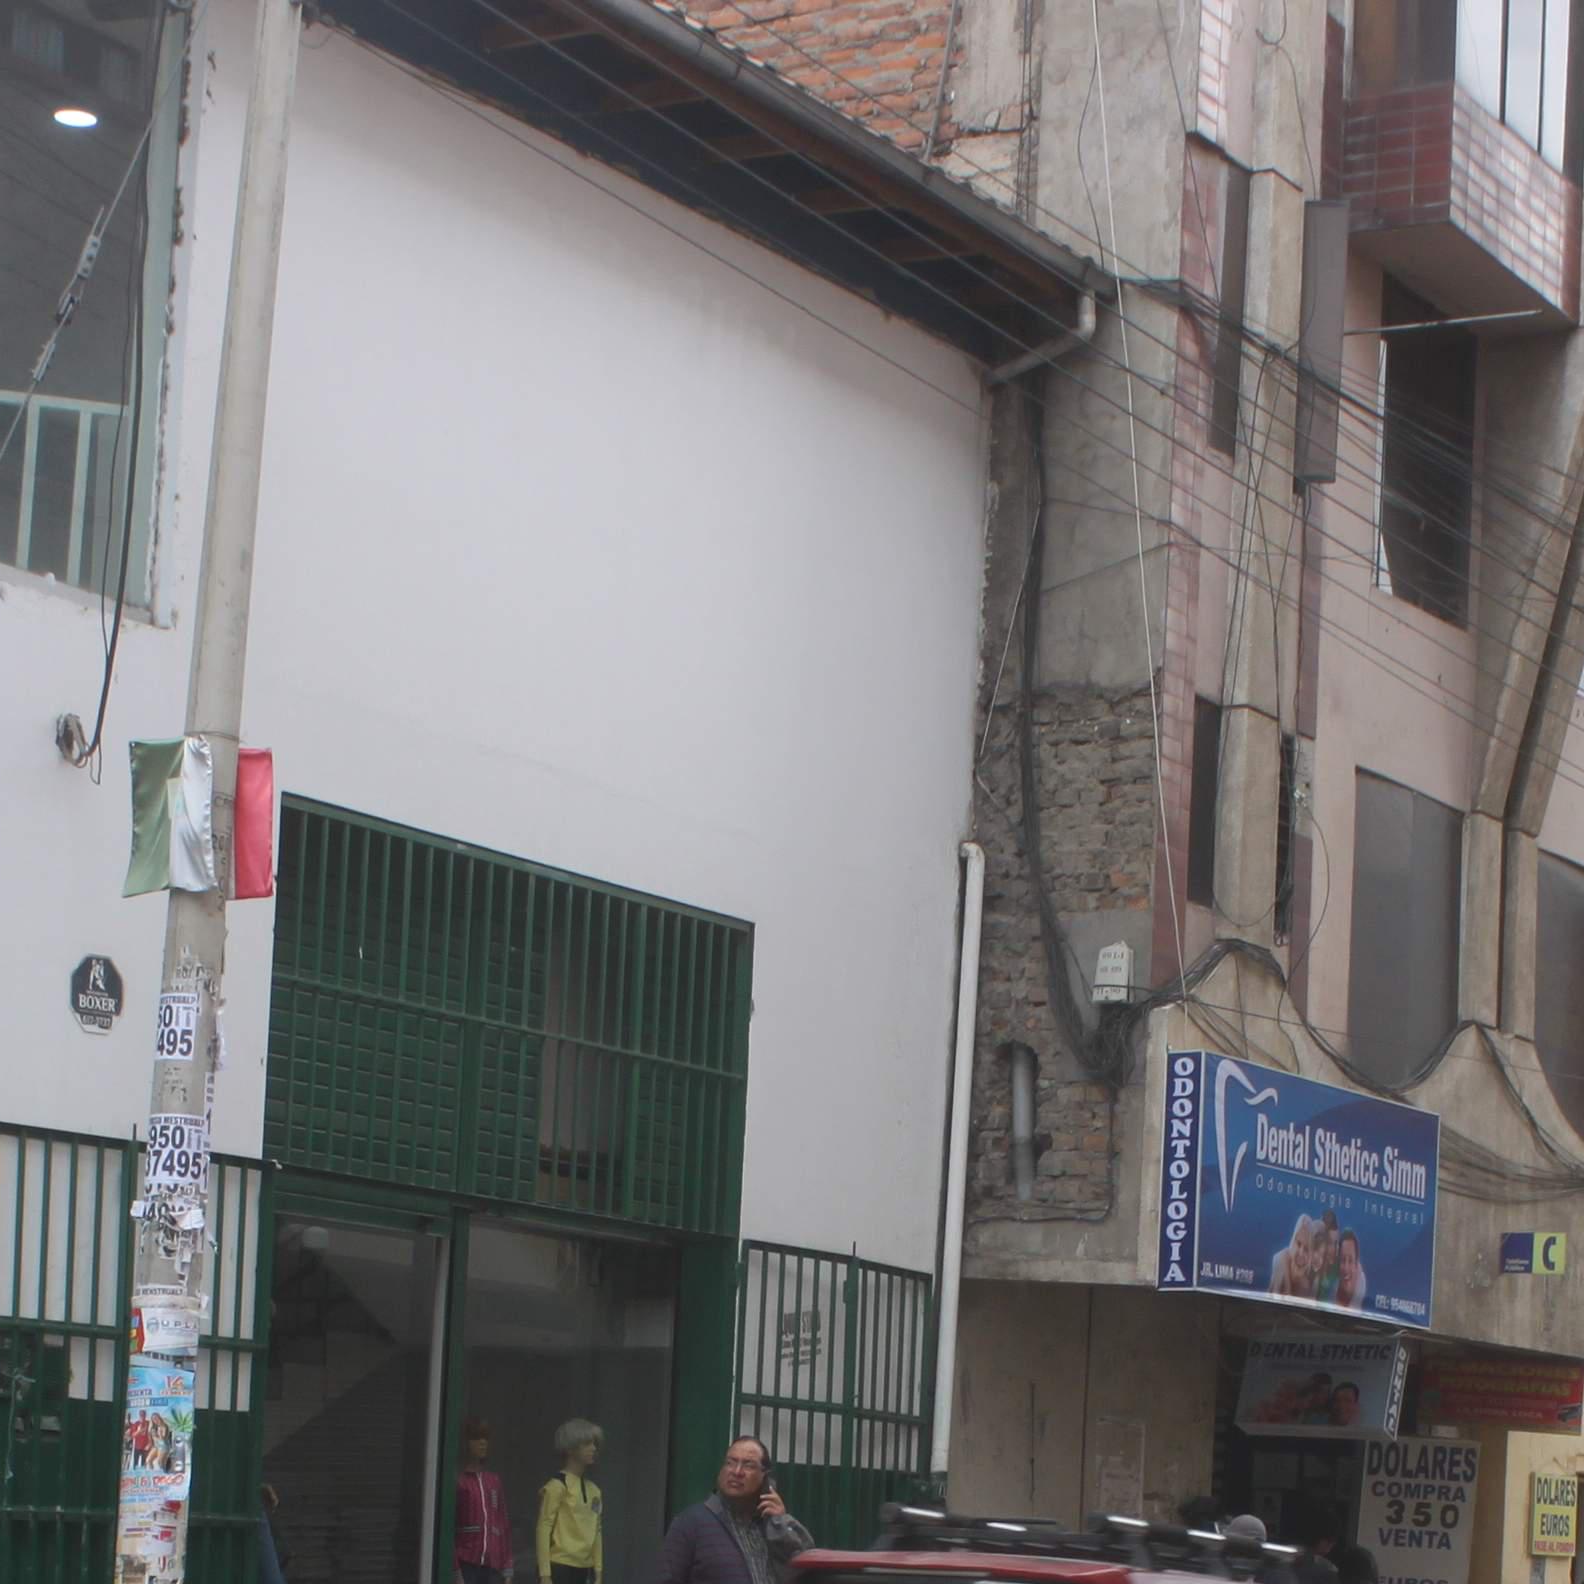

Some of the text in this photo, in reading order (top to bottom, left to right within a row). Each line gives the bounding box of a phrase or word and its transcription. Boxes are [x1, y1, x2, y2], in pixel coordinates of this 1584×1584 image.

[78, 993, 116, 1013] BOXER
[149, 1125, 185, 1149] 950
[1255, 1112, 1426, 1200] Dental Stheticc Simm
[1163, 1057, 1195, 1282] ODONTOLOGIA
[1364, 1199, 1425, 1226] Integral
[1367, 1440, 1477, 1483] DOLARES
[1371, 1481, 1467, 1503] COMPRA
[1536, 1477, 1576, 1507] DOLARES
[1540, 1512, 1570, 1537] EUROS
[1378, 1528, 1452, 1550] VENTA
